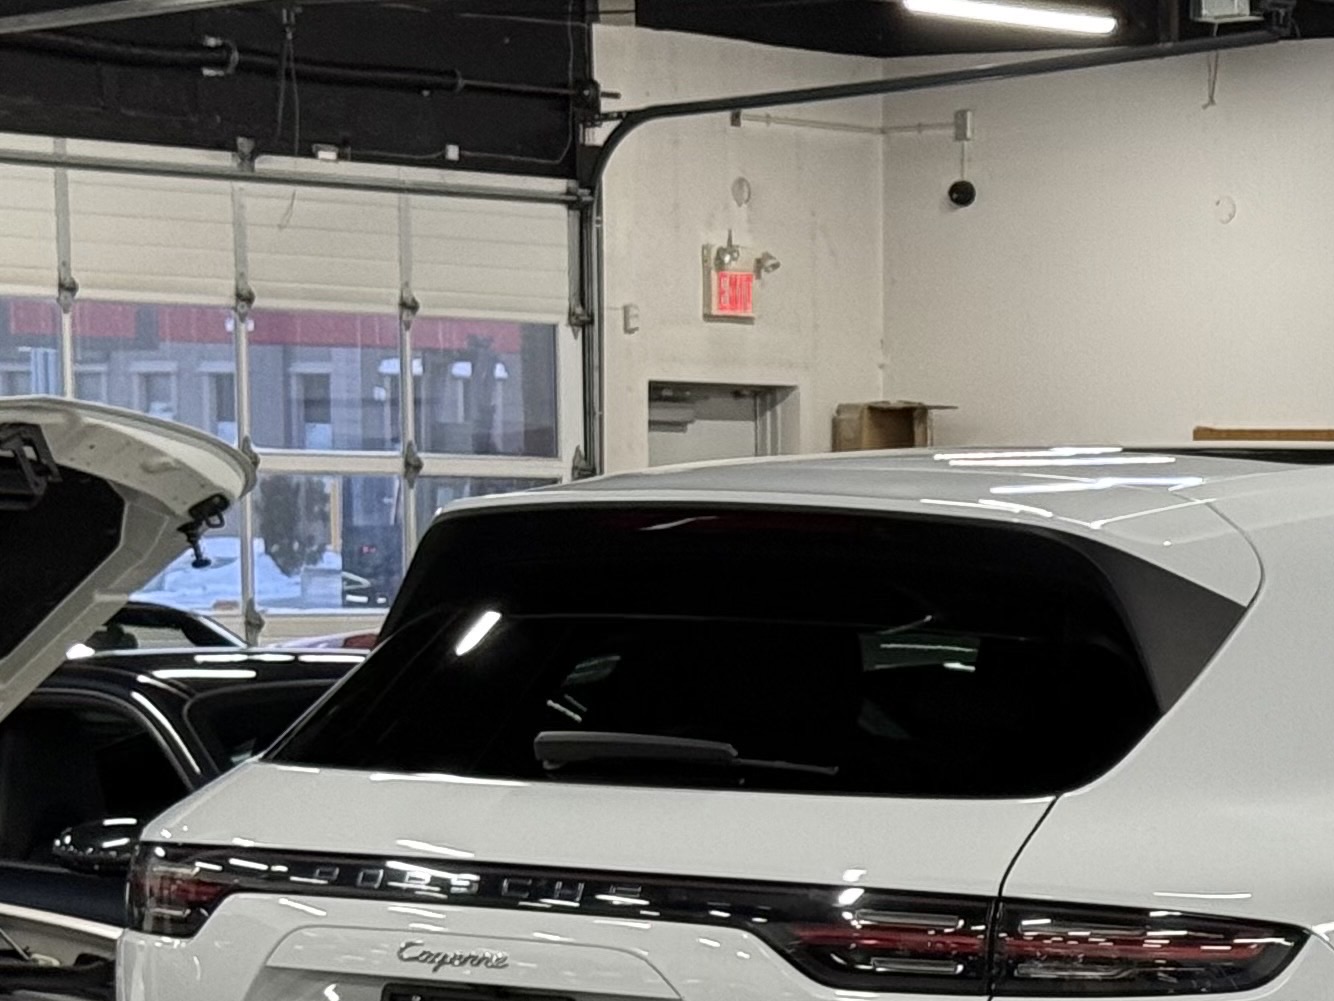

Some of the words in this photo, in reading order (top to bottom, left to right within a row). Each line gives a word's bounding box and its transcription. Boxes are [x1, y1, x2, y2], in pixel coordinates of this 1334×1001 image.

[719, 273, 753, 310] EXIT
[313, 865, 643, 905] PORSCHE
[398, 940, 508, 972] Cayenne
